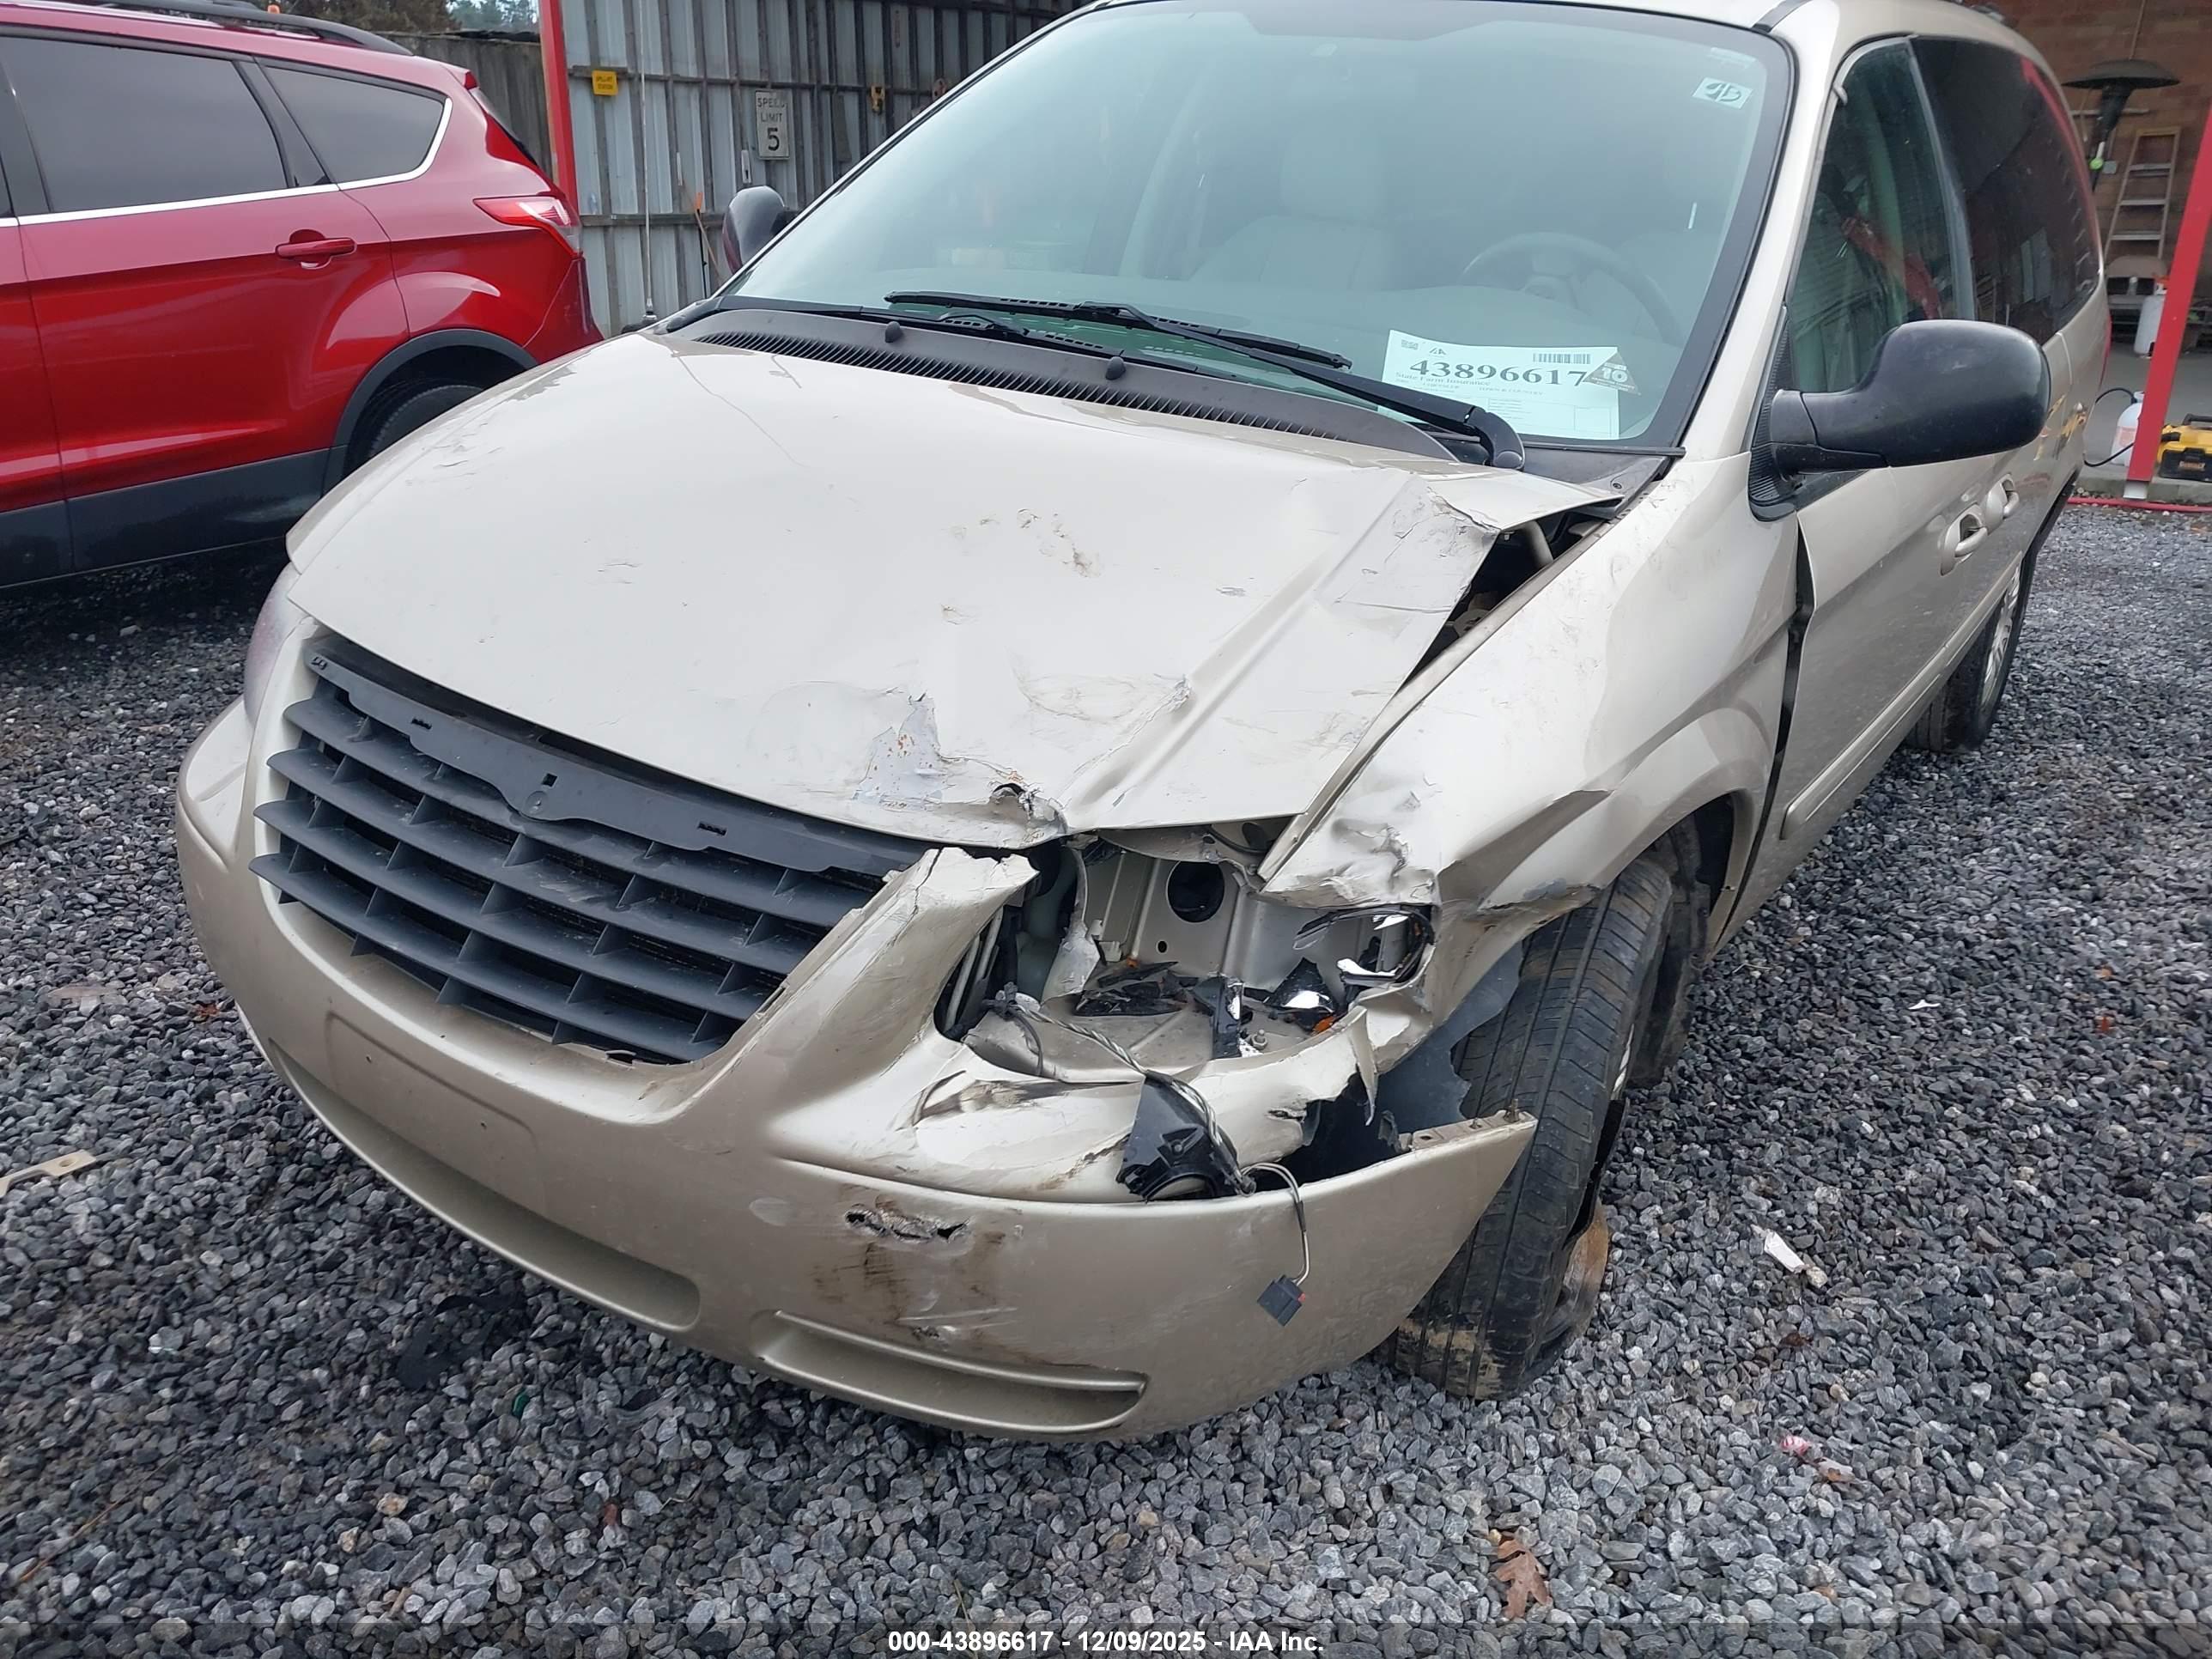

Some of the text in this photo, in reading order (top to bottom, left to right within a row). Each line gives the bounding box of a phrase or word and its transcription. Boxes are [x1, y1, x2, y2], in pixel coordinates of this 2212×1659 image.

[761, 112, 783, 123] LIMIT
[767, 127, 780, 151] 5
[1409, 360, 1588, 386] 43896617
[1601, 367, 1628, 383] 10
